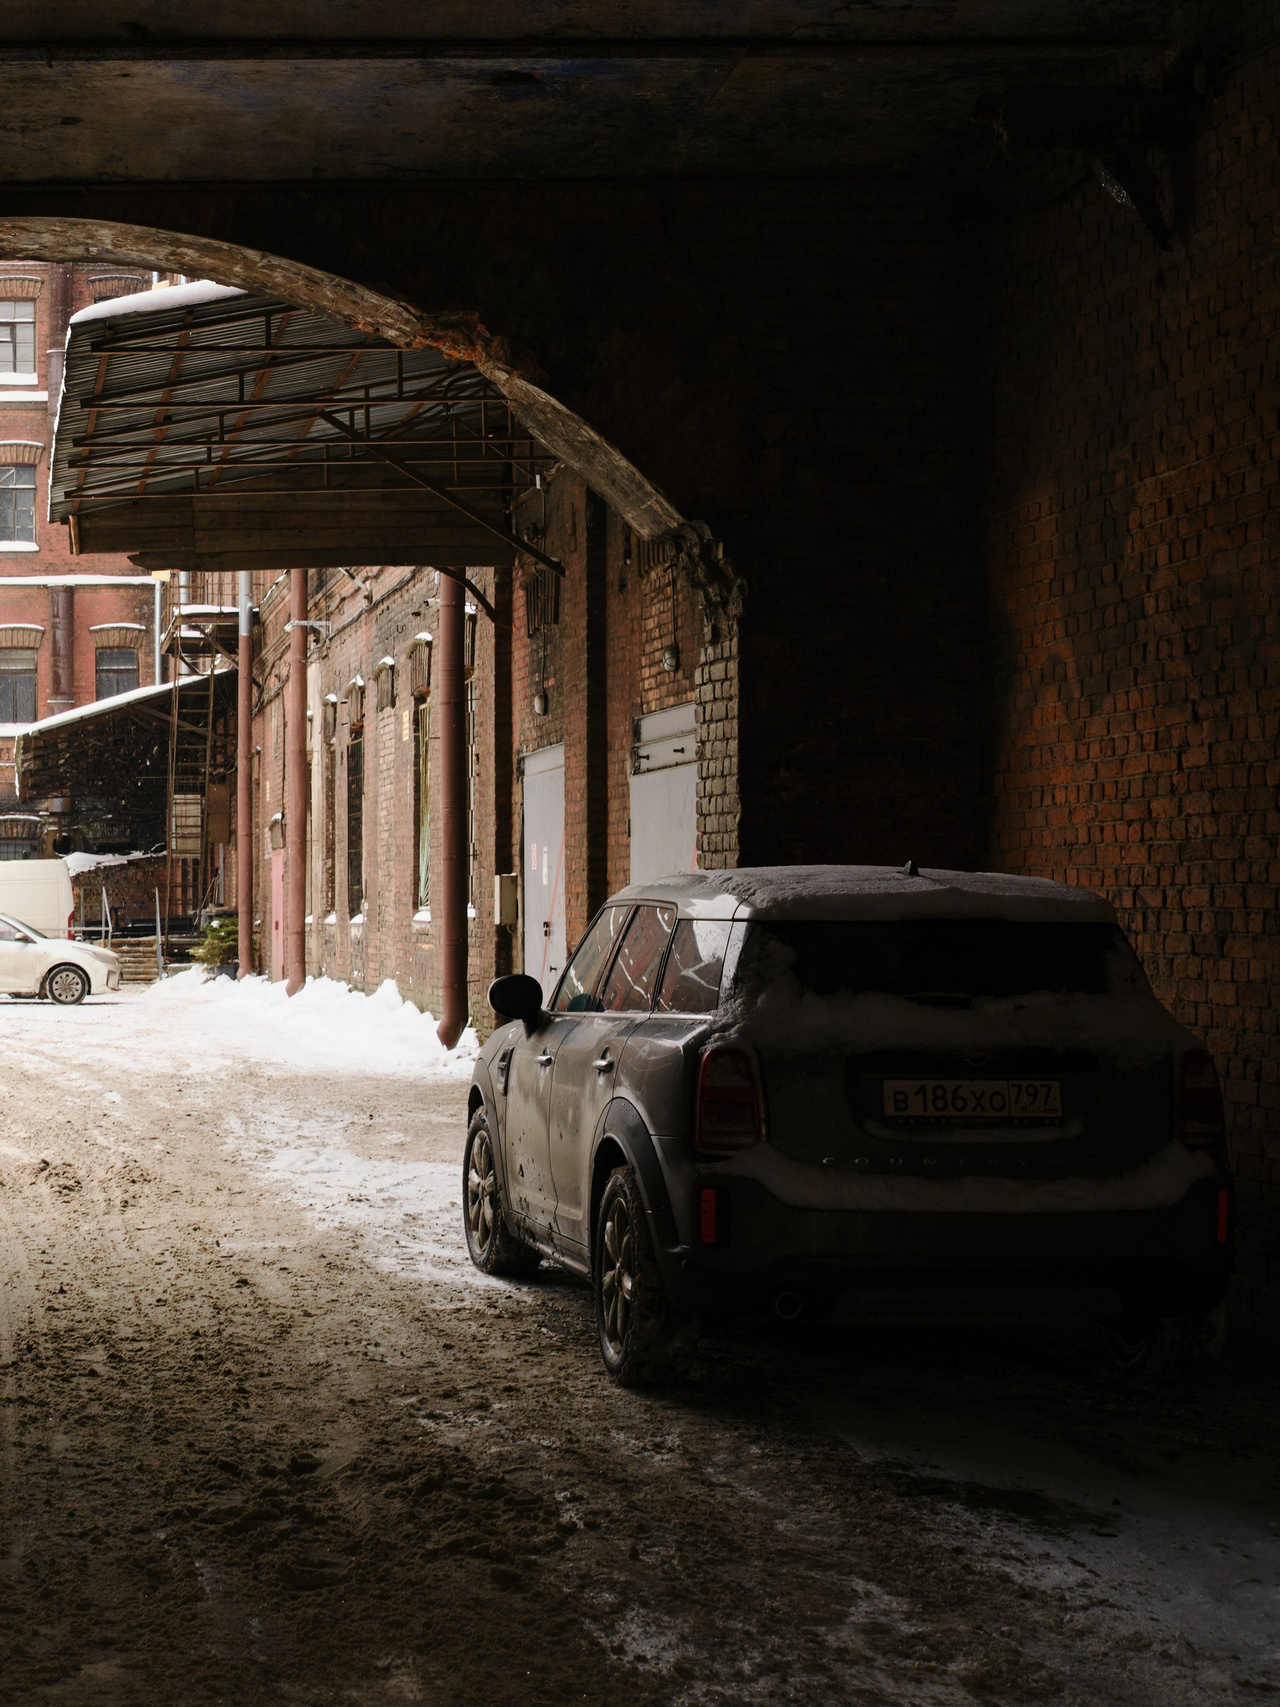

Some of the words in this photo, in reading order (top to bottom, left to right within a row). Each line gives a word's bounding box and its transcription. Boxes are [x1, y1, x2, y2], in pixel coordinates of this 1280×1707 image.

[1010, 1083, 1052, 1105] 797
[1021, 1105, 1043, 1114] RUS
[821, 1156, 1100, 1167] COUNTRYMA
